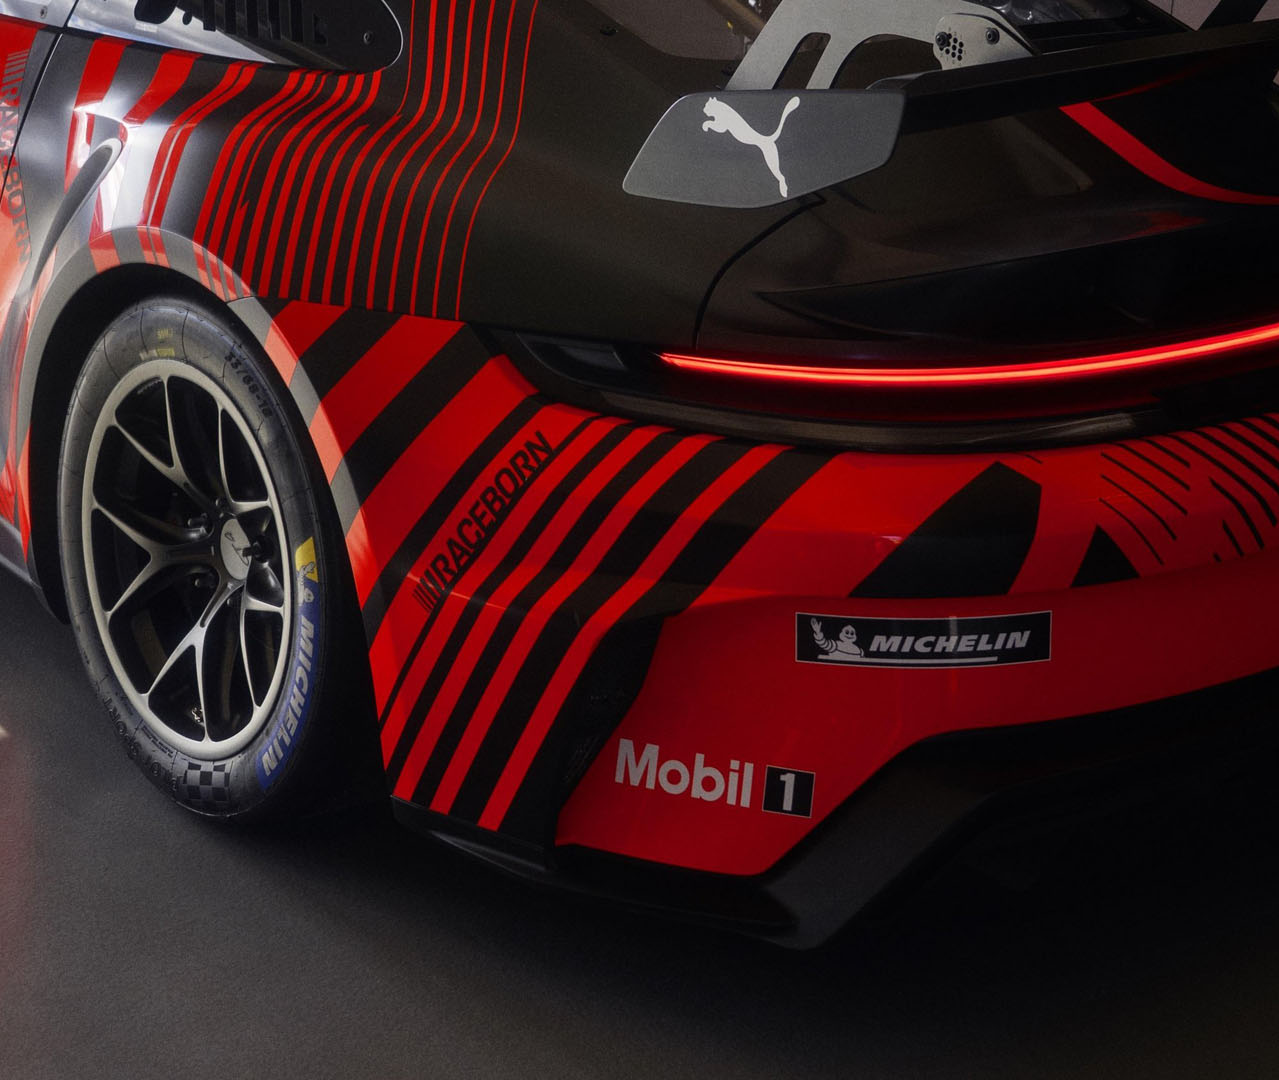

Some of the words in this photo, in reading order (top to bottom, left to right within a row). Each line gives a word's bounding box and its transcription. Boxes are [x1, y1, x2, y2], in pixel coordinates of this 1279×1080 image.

[428, 430, 553, 592] RACEBORN
[261, 615, 315, 776] MICHELIN
[869, 630, 1031, 654] MICHELIN
[614, 738, 754, 808] Mobil
[780, 773, 796, 811] 1
